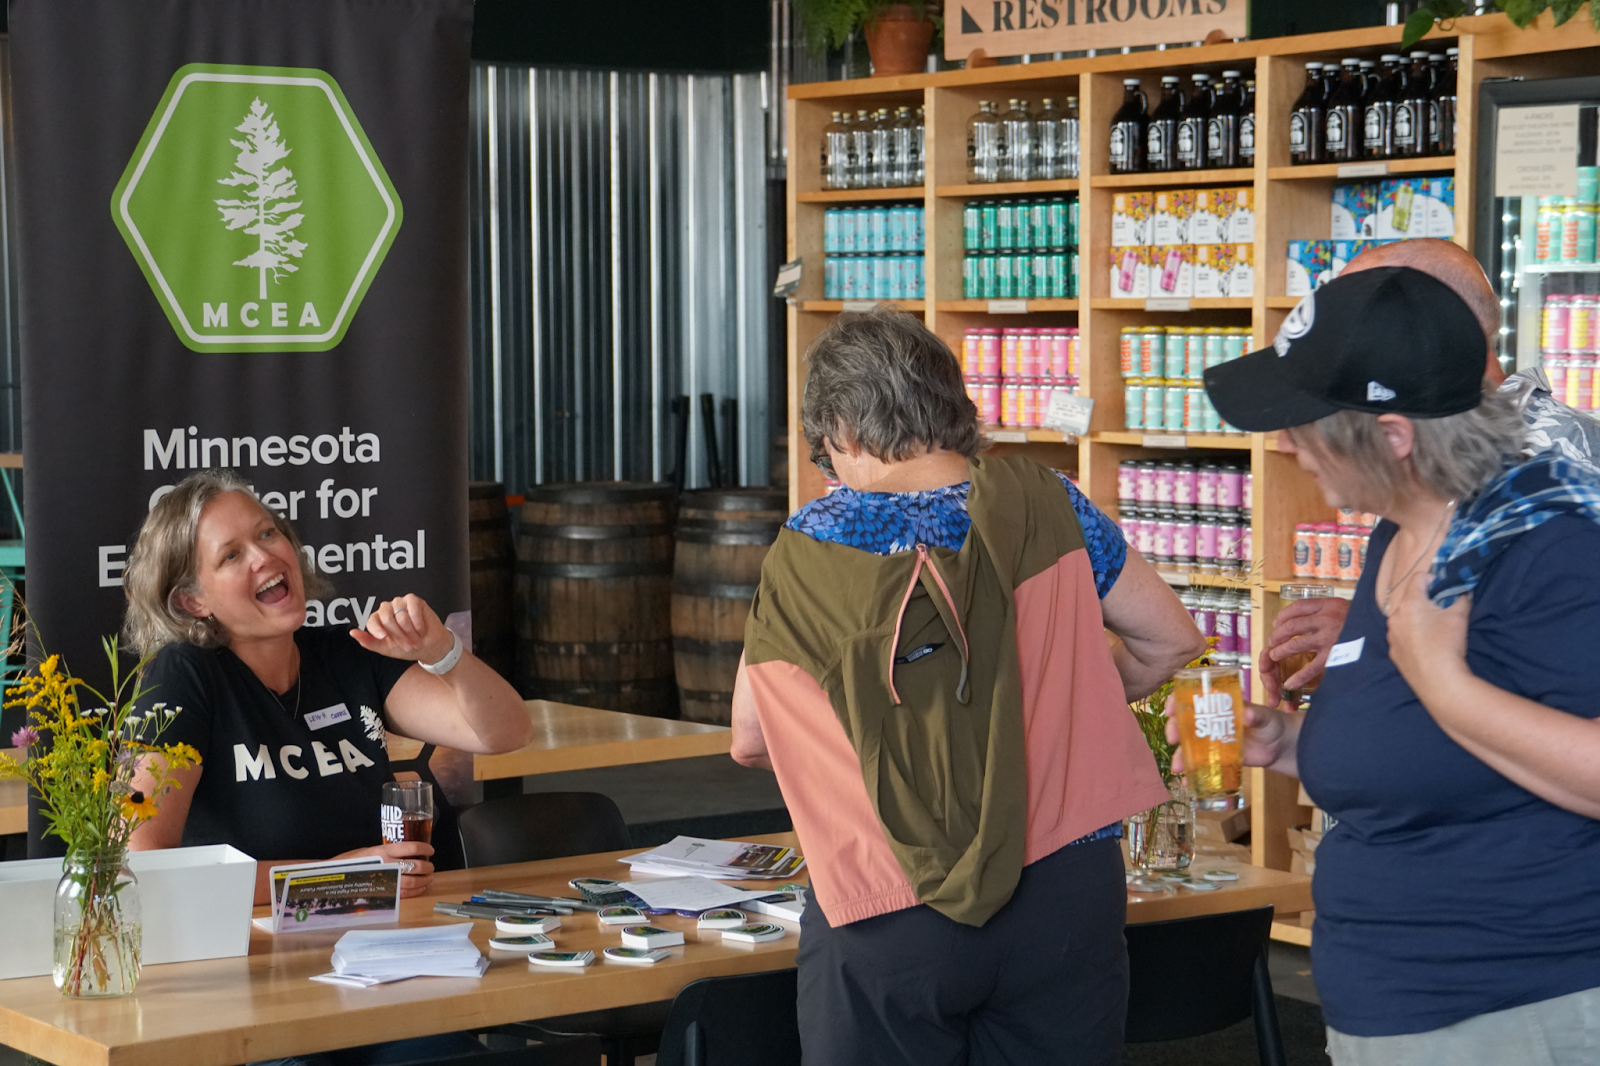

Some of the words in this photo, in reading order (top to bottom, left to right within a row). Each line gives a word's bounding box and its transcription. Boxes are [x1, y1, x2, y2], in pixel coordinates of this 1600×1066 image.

[203, 302, 321, 328] MCEA
[143, 425, 381, 470] Minnesota
[316, 478, 378, 519] for
[233, 738, 375, 782] MCEA
